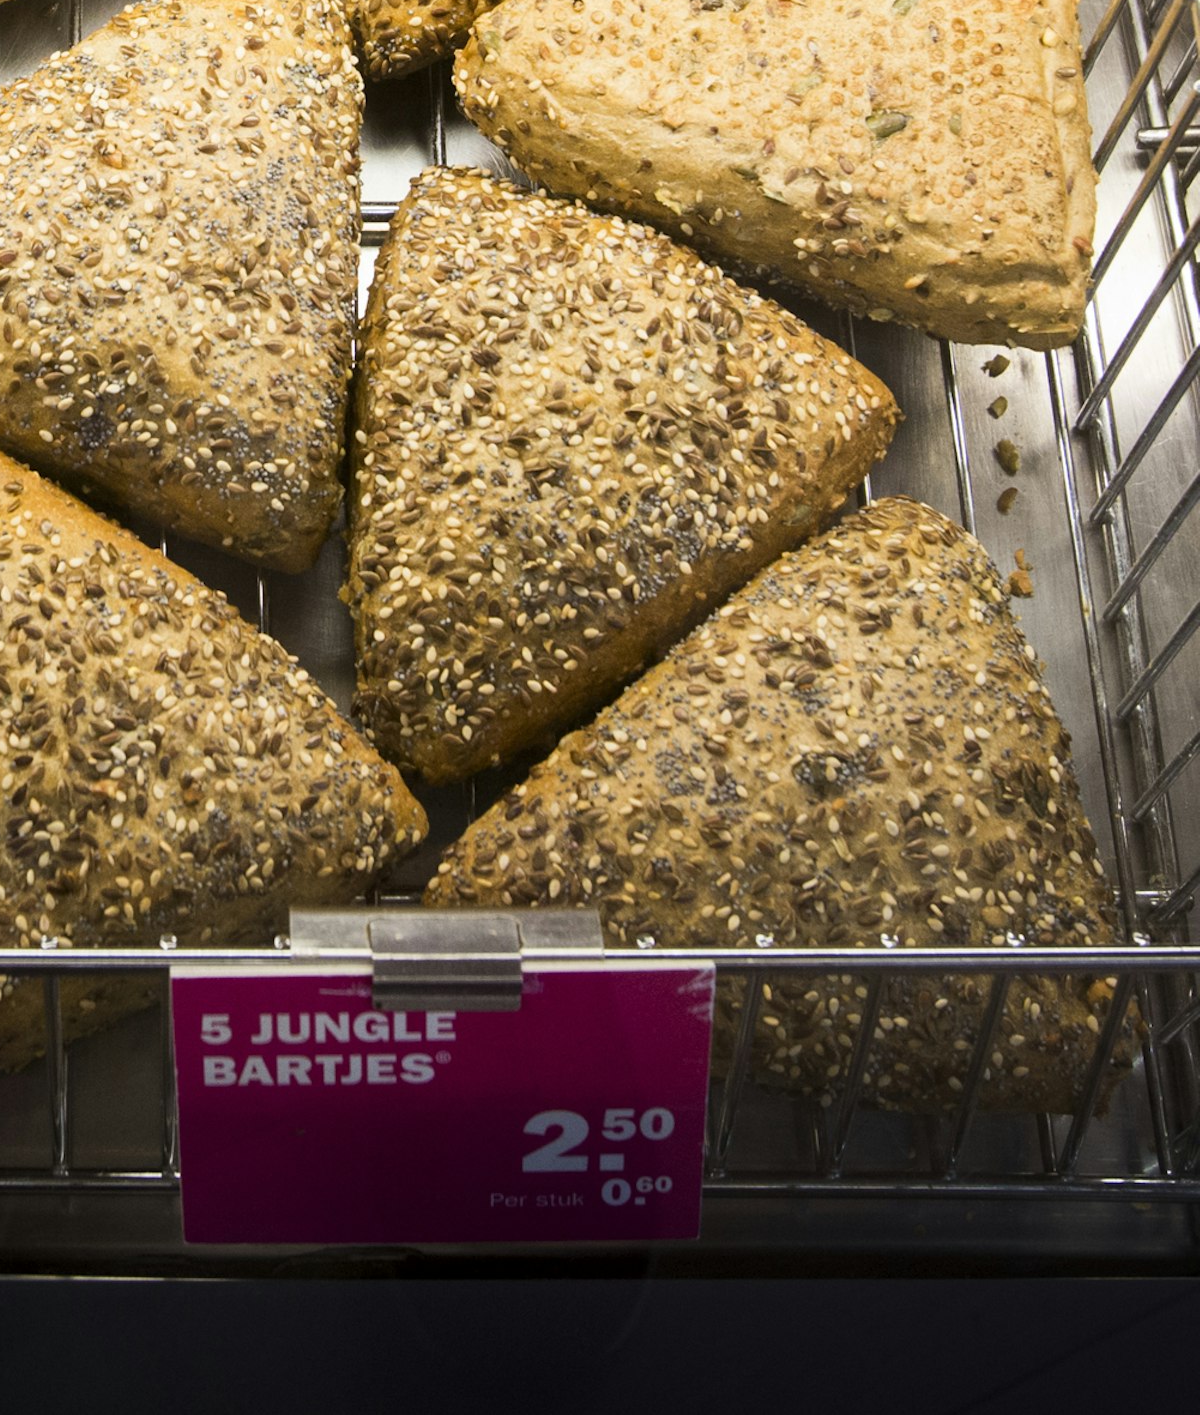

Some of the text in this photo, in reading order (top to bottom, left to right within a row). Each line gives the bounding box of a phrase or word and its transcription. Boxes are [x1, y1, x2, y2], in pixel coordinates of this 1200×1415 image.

[201, 1012, 456, 1044] 5 JUNGLE
[490, 1192, 527, 1207] Per
[535, 1191, 585, 1208] stuk
